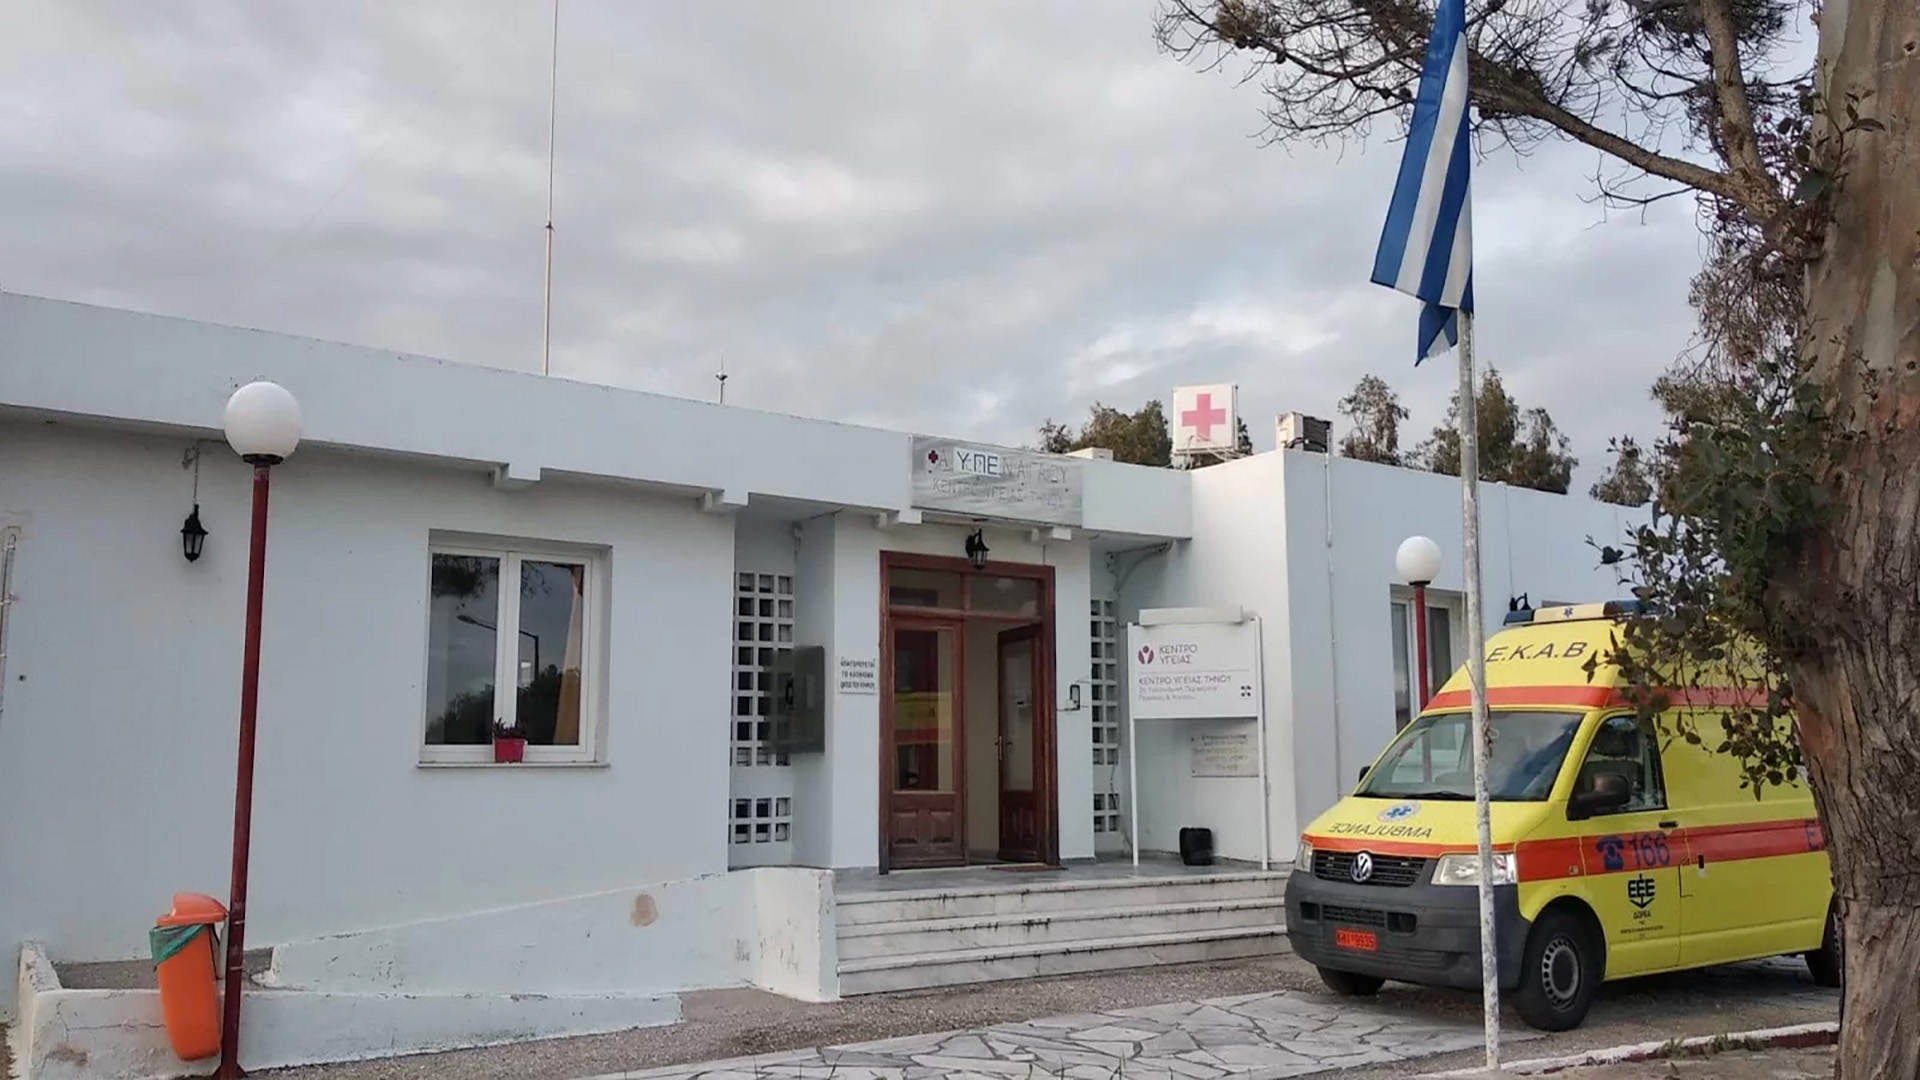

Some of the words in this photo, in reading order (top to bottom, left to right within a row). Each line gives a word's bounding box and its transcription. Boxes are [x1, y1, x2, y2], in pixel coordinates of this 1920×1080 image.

[1159, 644, 1198, 655] ΚΕΝΤΡΟ
[1160, 655, 1192, 665] ΥΓΕΙΑΣ
[1139, 676, 1172, 686] ΚΕΝΤΡΟ
[1173, 675, 1202, 685] ΥΓΕΙΑΣ
[1629, 831, 1671, 867] 166
